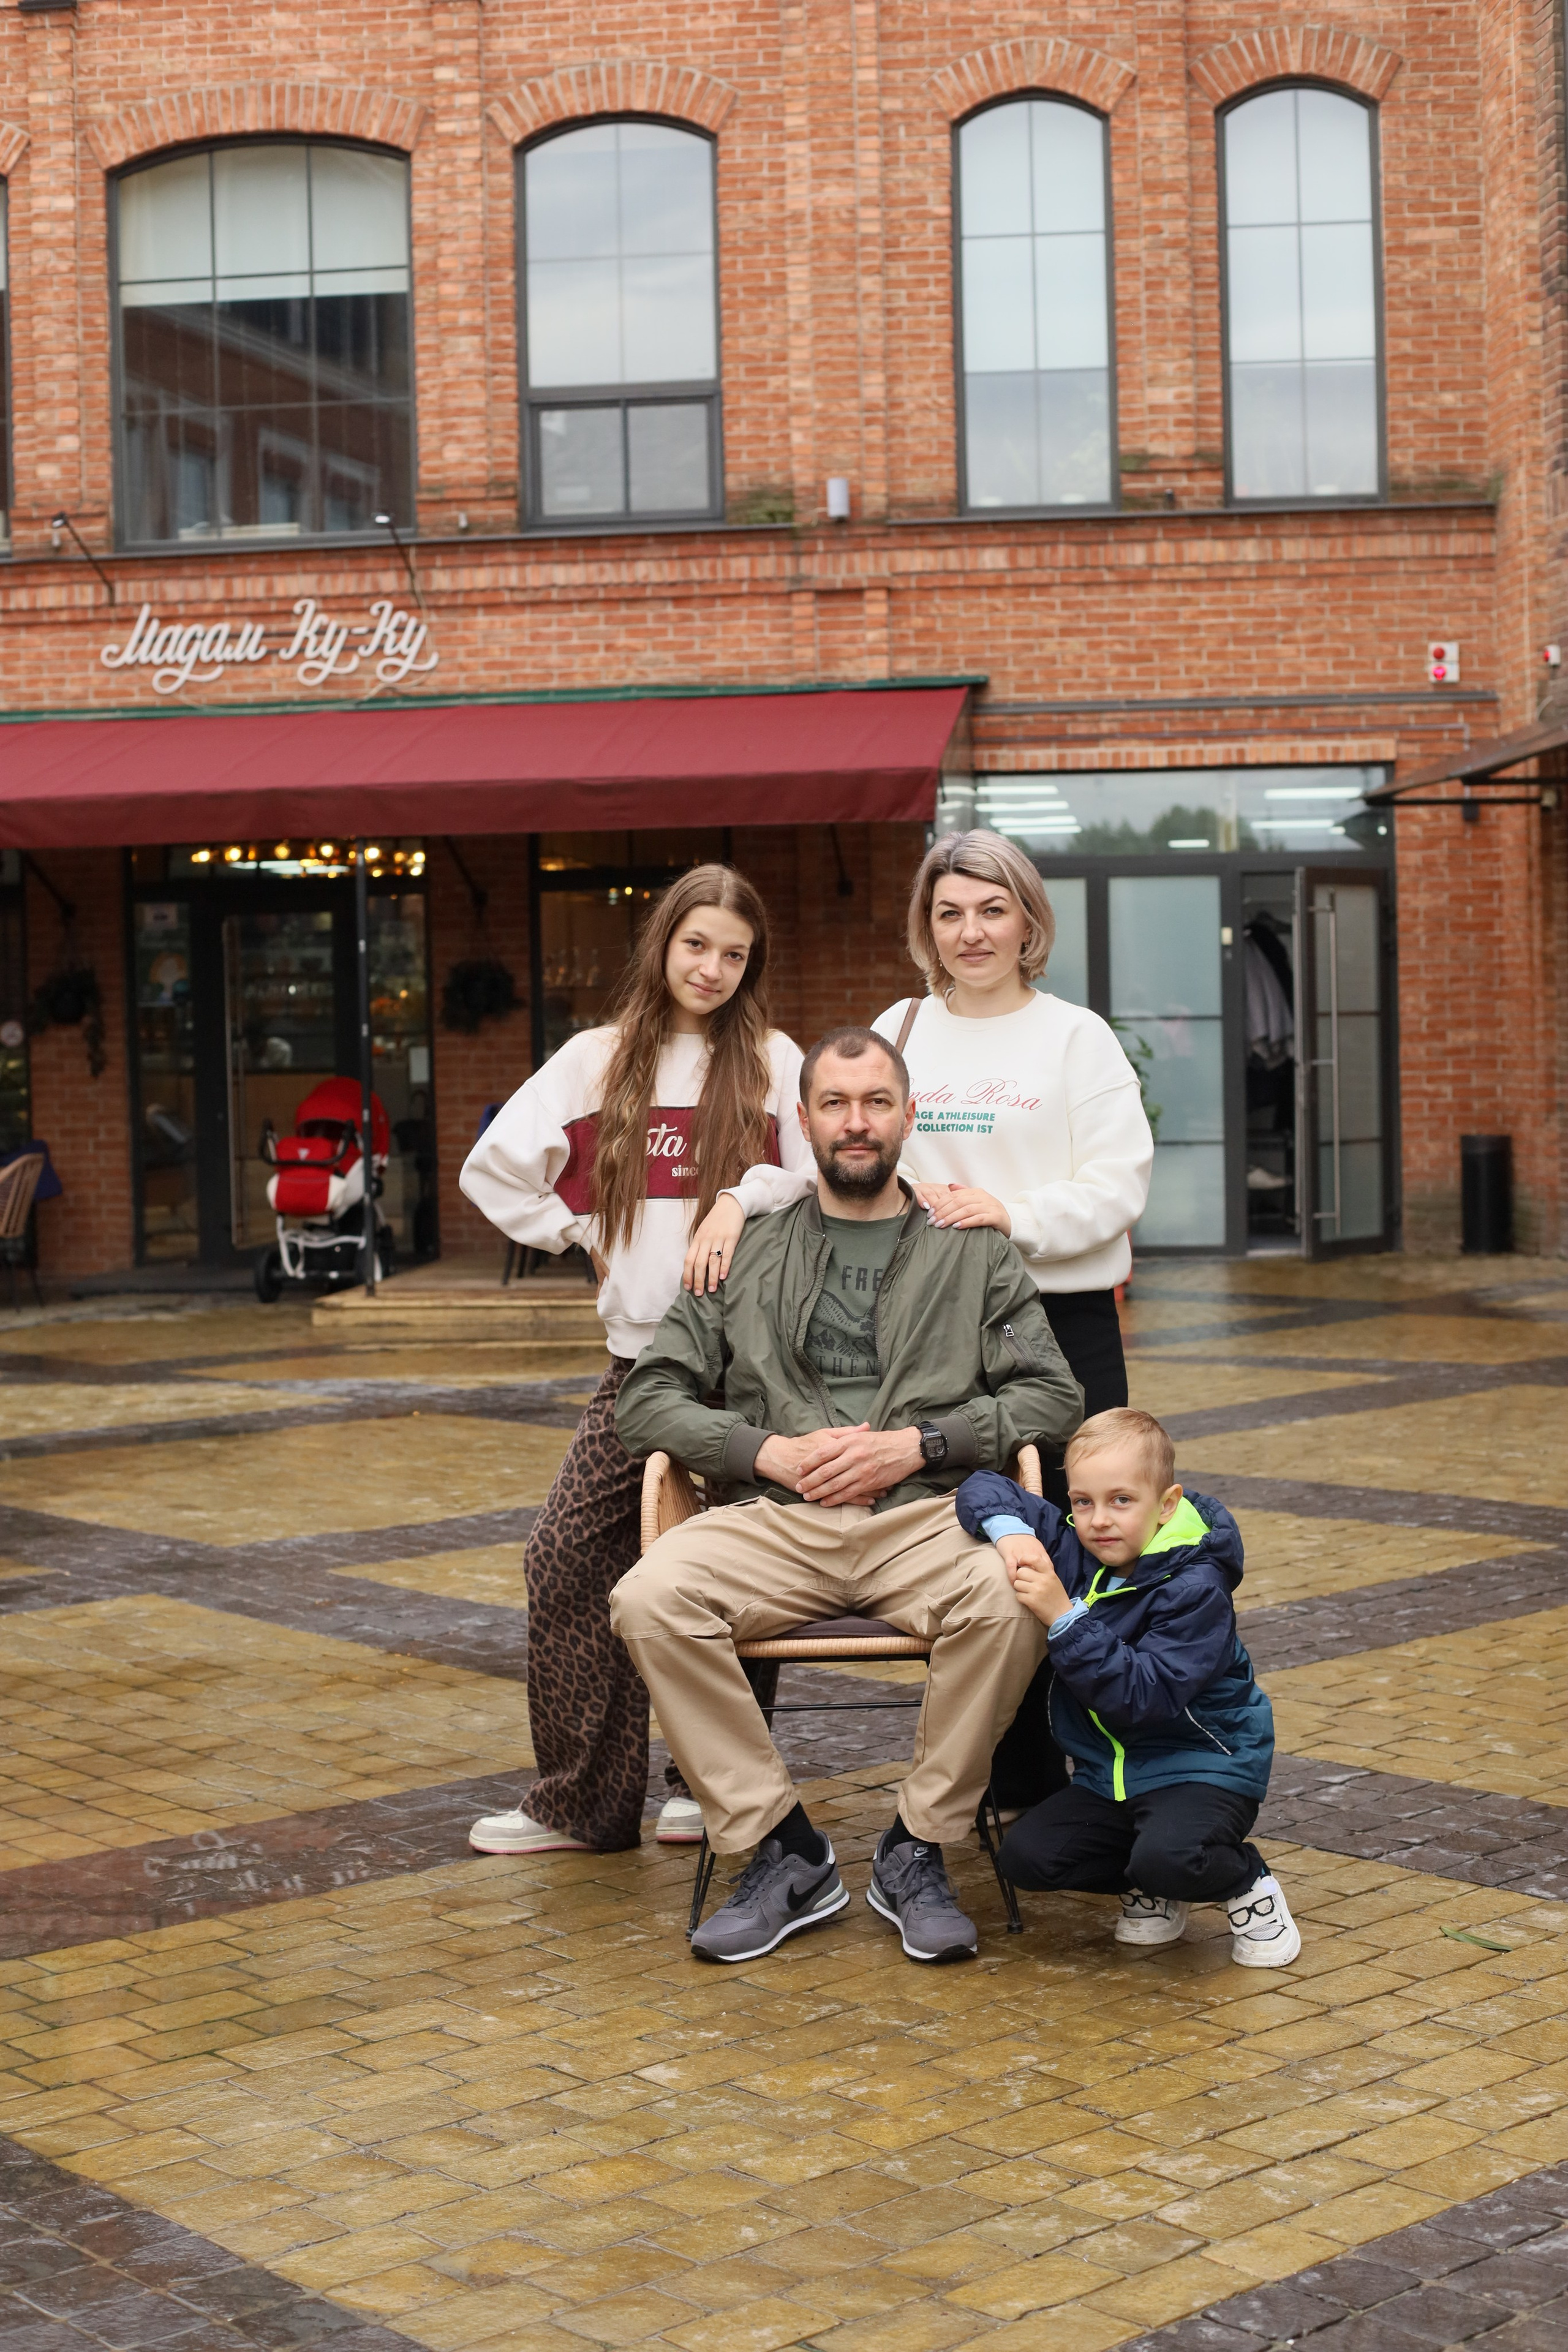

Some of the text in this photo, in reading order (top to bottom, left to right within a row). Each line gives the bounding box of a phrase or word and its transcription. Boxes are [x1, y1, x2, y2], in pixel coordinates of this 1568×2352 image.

[100, 598, 440, 695] Мадам Ку-Ку
[908, 1077, 1044, 1110] nda Rosa
[937, 1112, 996, 1121] ATHLEISURE
[916, 1123, 974, 1133] COLLECTION
